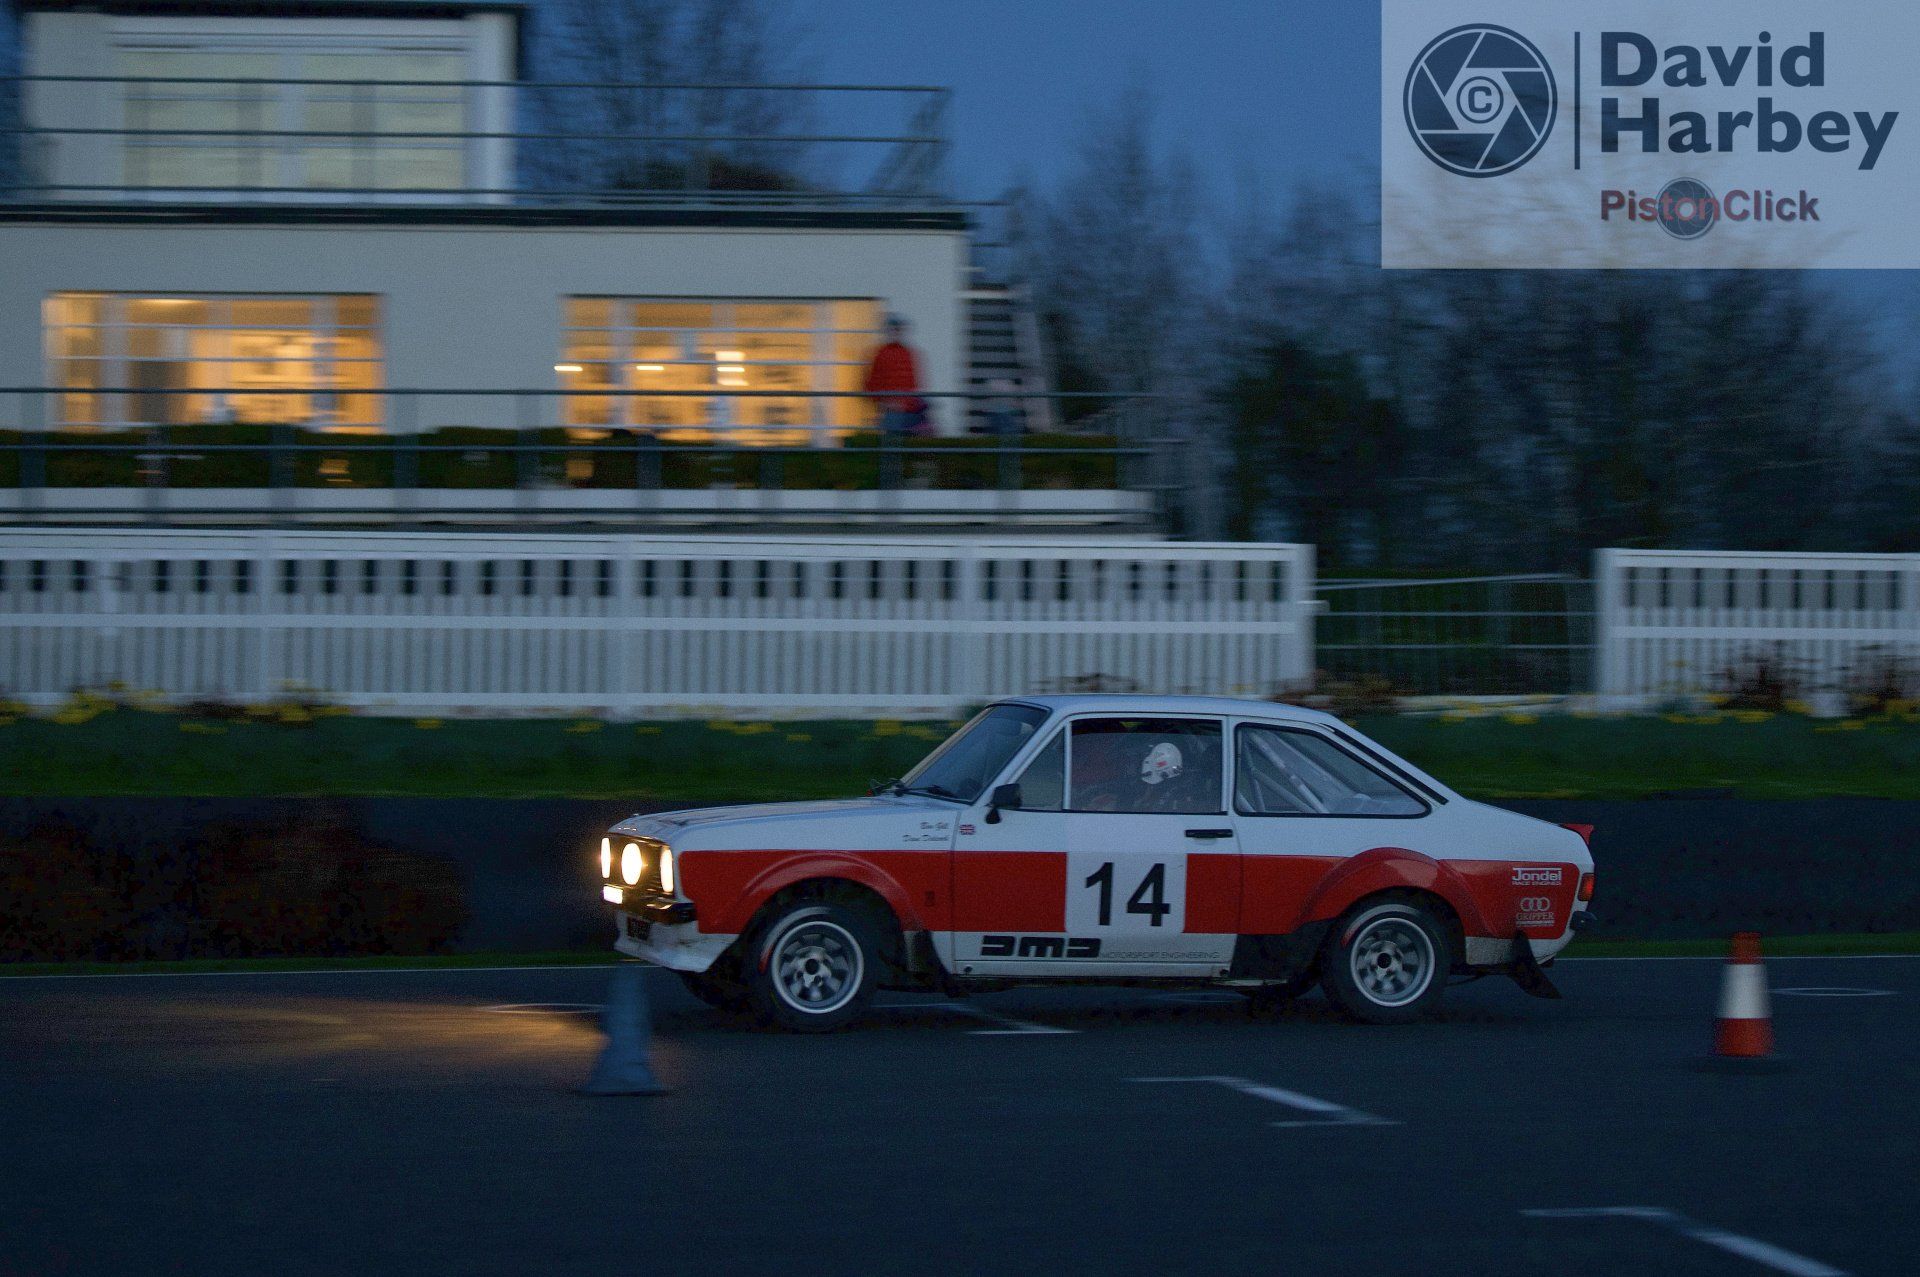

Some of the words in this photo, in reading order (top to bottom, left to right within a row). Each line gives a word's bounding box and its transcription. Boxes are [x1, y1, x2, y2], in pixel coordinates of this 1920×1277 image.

[1511, 867, 1562, 881] Jondel
[1085, 861, 1171, 927] 14
[1515, 911, 1555, 920] GRIPPER
[1101, 951, 1160, 959] MOTORSPORT
[1161, 951, 1220, 960] ENGINEERING
